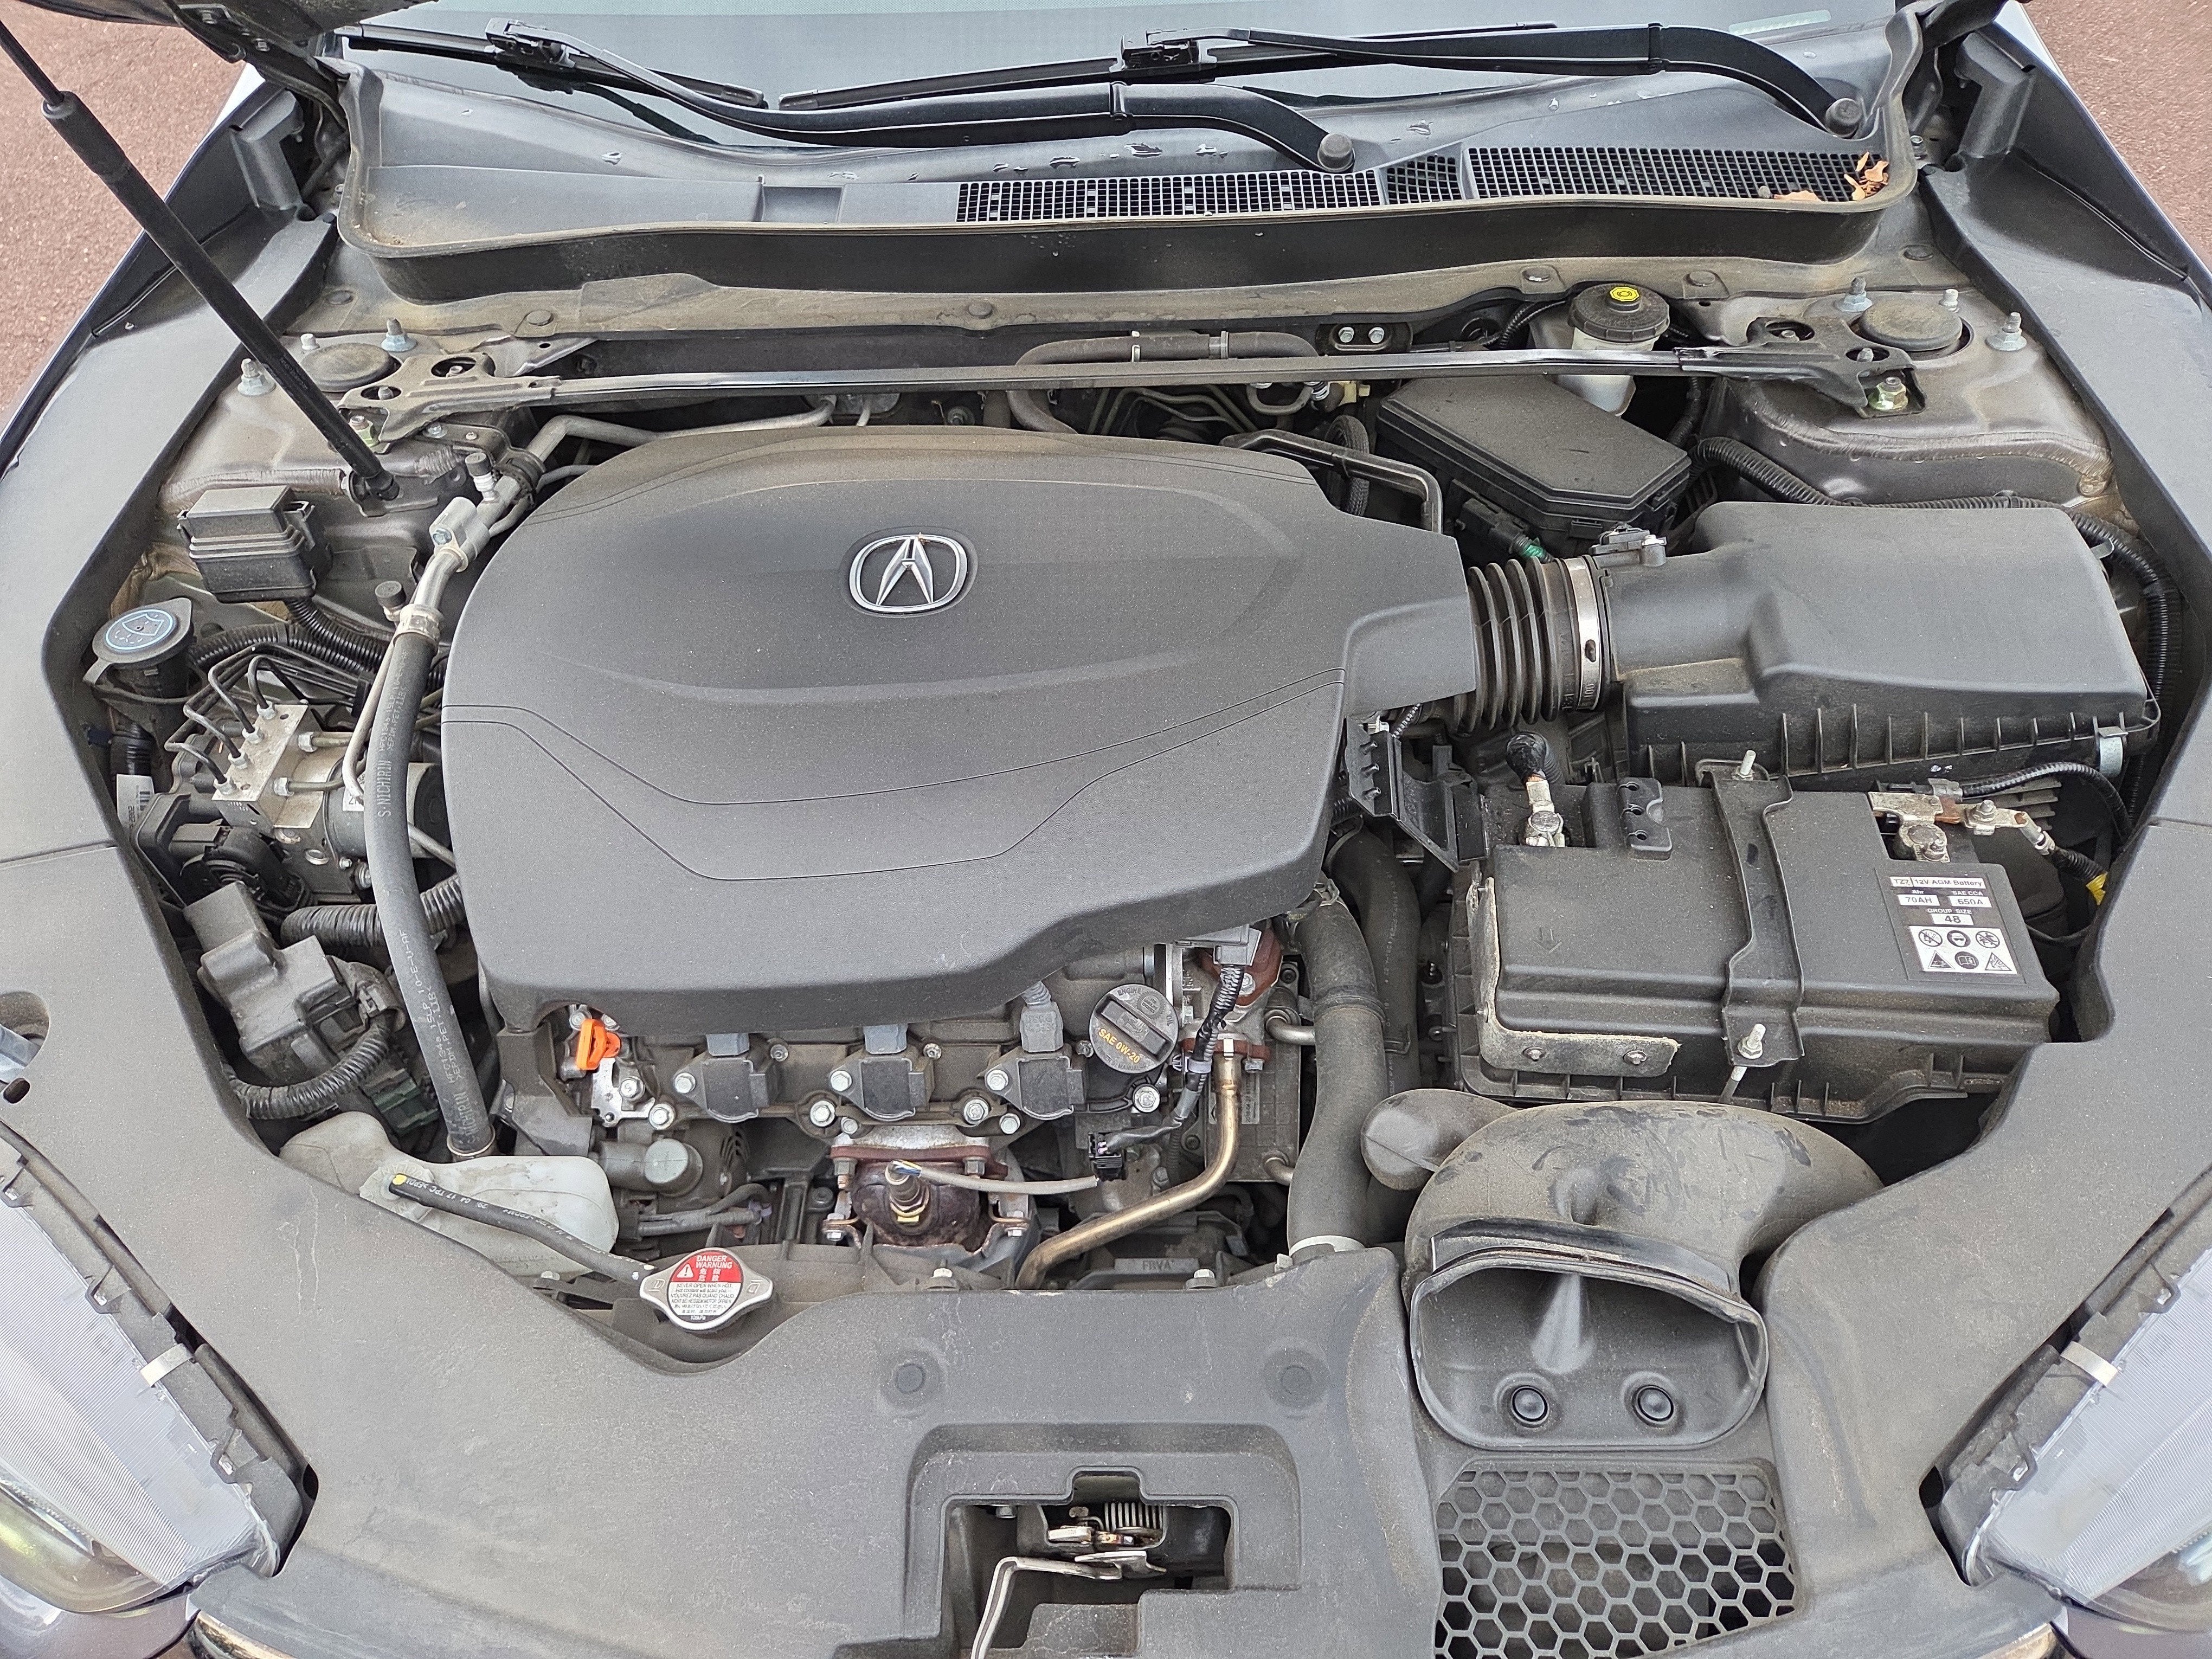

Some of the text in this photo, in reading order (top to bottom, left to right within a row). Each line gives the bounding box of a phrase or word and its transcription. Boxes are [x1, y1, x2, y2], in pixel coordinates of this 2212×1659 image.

[1944, 915, 1961, 923] 48
[399, 930, 425, 994] 10-E-U-AF
[435, 1036, 455, 1084] HFC134a
[1098, 1028, 1117, 1045] SAE
[1116, 1041, 1141, 1064] 0W-20
[429, 1186, 445, 1197] TPC
